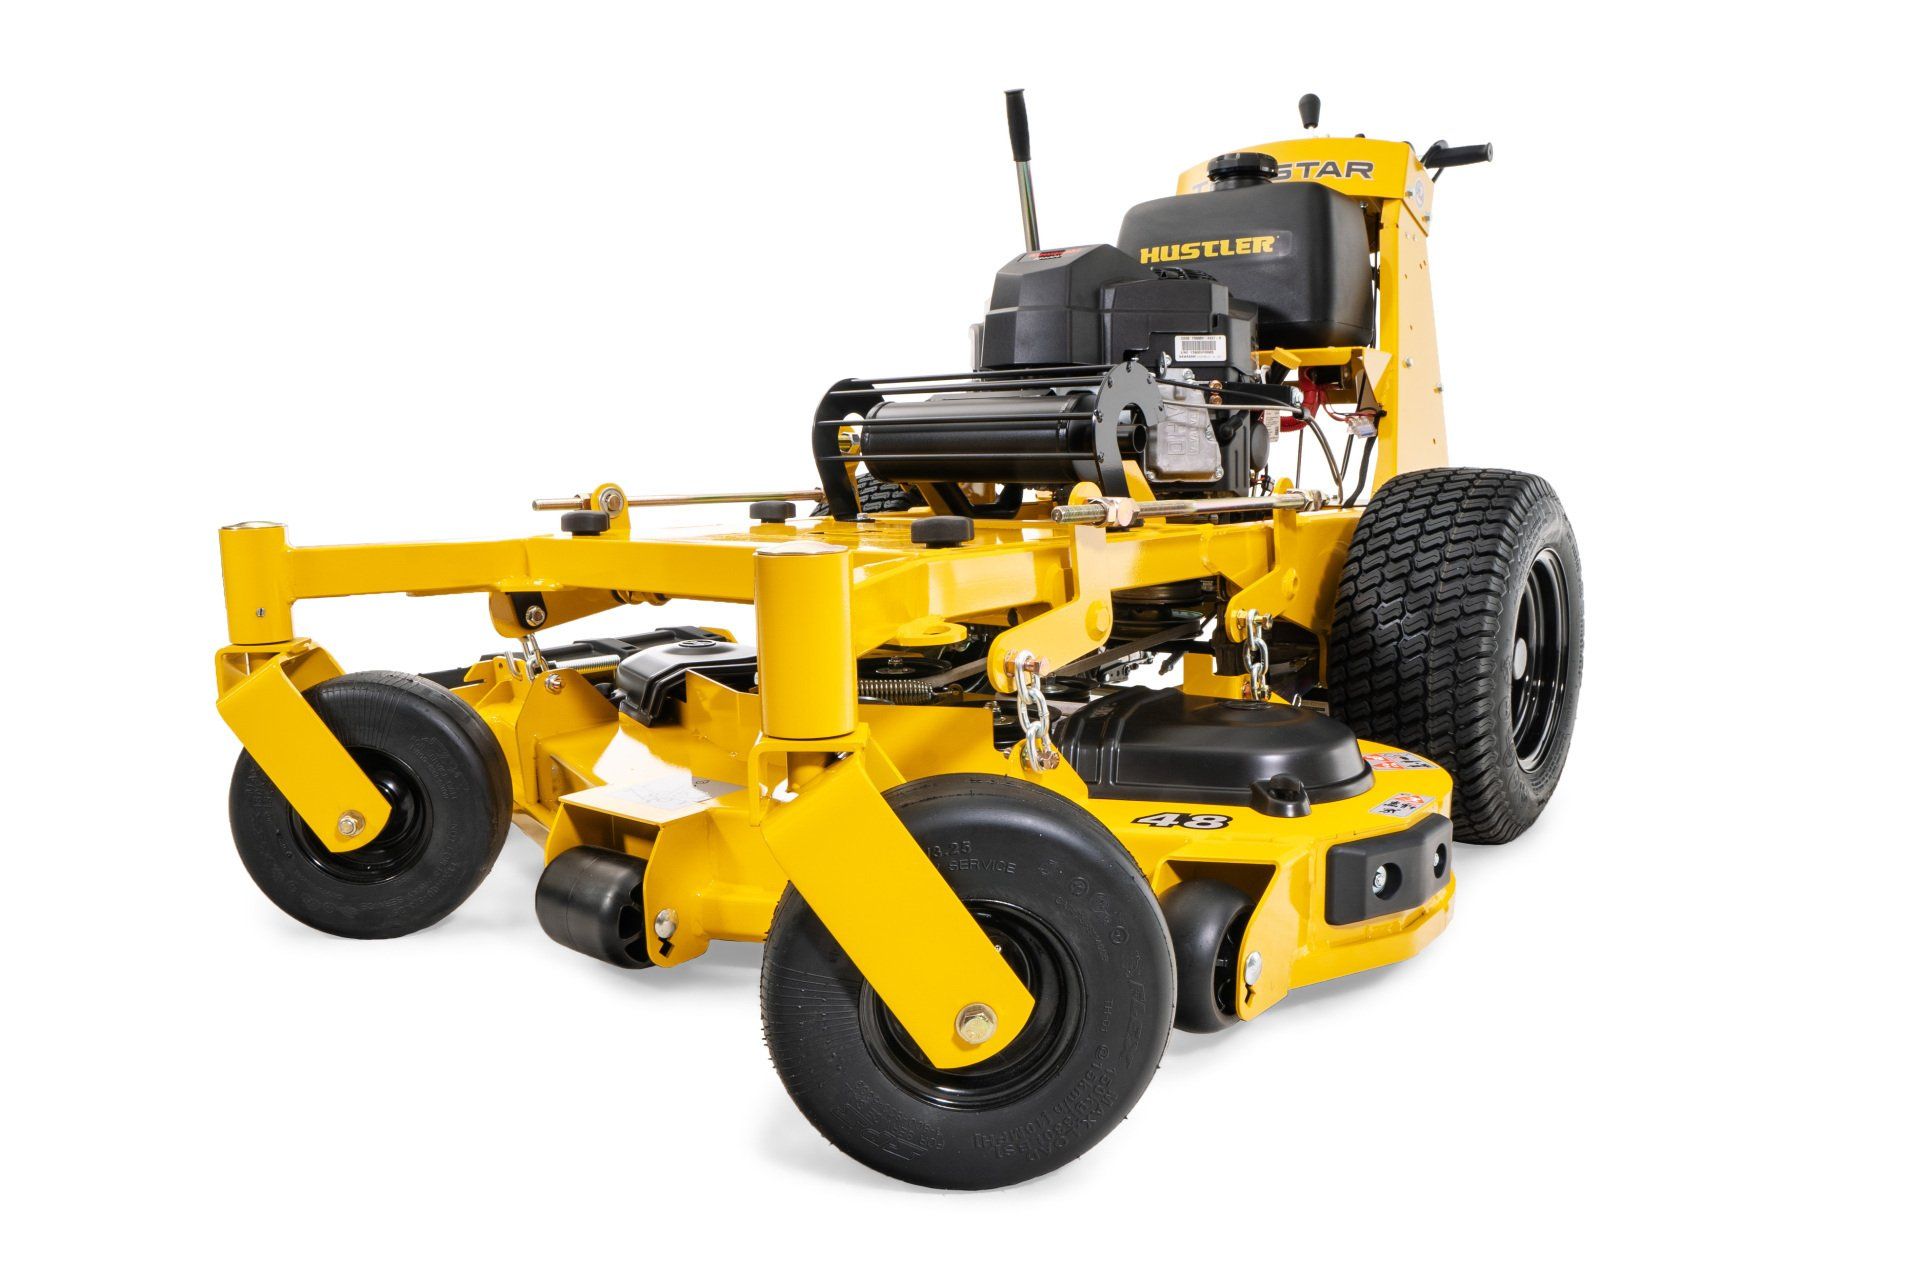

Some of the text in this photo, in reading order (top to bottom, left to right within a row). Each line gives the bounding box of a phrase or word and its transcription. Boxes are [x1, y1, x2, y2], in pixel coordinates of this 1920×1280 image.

[1140, 235, 1275, 264] HUSTLER
[1133, 812, 1231, 829] 48
[948, 858, 1017, 874] SERVICE
